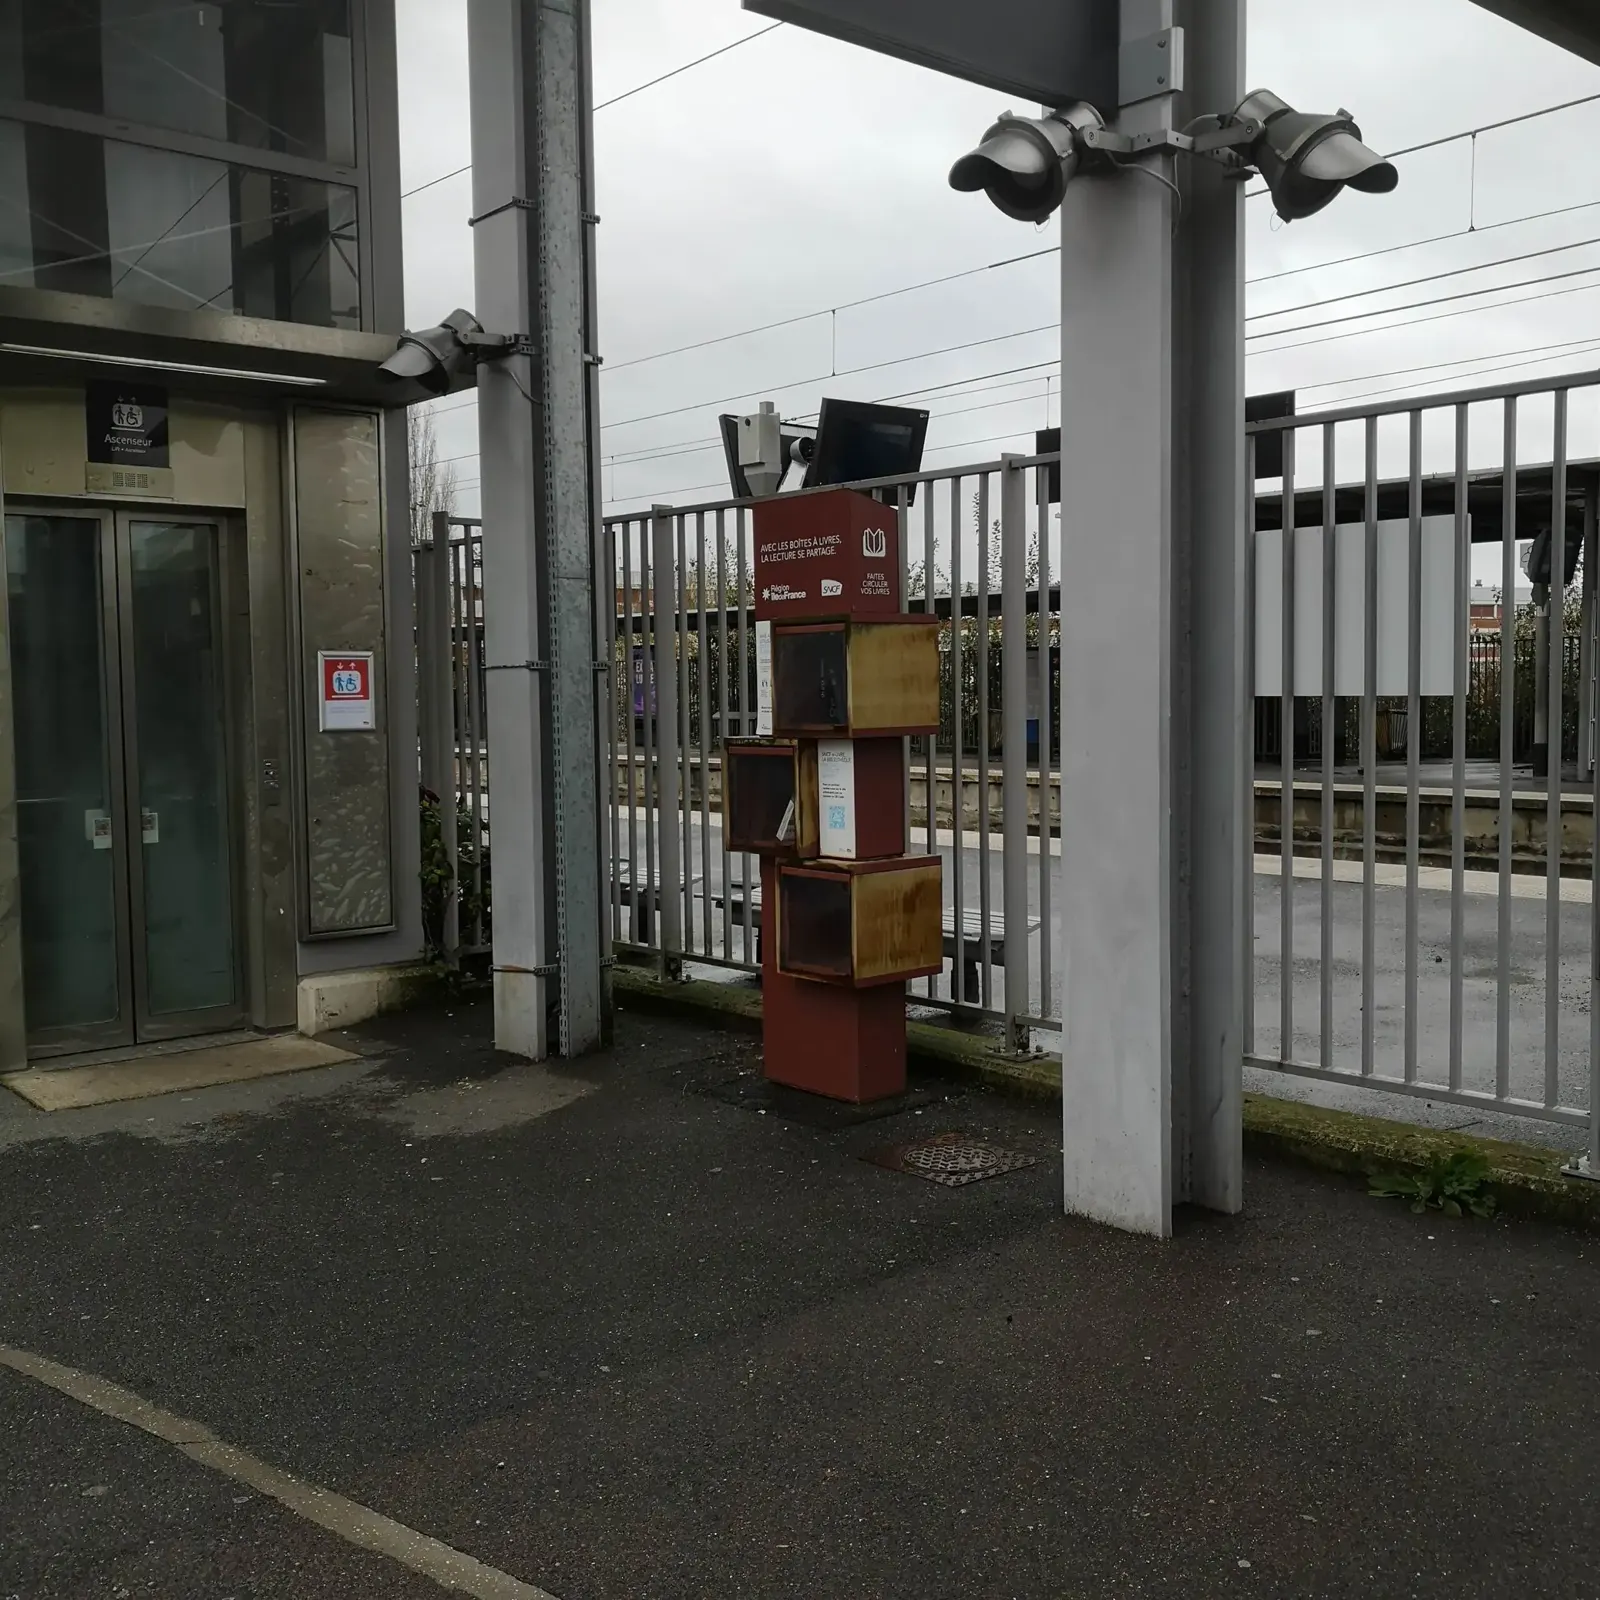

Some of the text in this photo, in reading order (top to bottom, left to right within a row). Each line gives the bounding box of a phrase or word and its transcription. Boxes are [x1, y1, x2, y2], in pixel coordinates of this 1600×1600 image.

[104, 433, 152, 446] Ascenseur
[760, 534, 842, 553] AVEC LES BOÎTES À LIVRES,
[761, 546, 837, 563] LA LECTURE SE PARTAGE.
[770, 584, 790, 594] Région
[823, 585, 841, 594] SNCF
[872, 588, 890, 596] LIVRES
